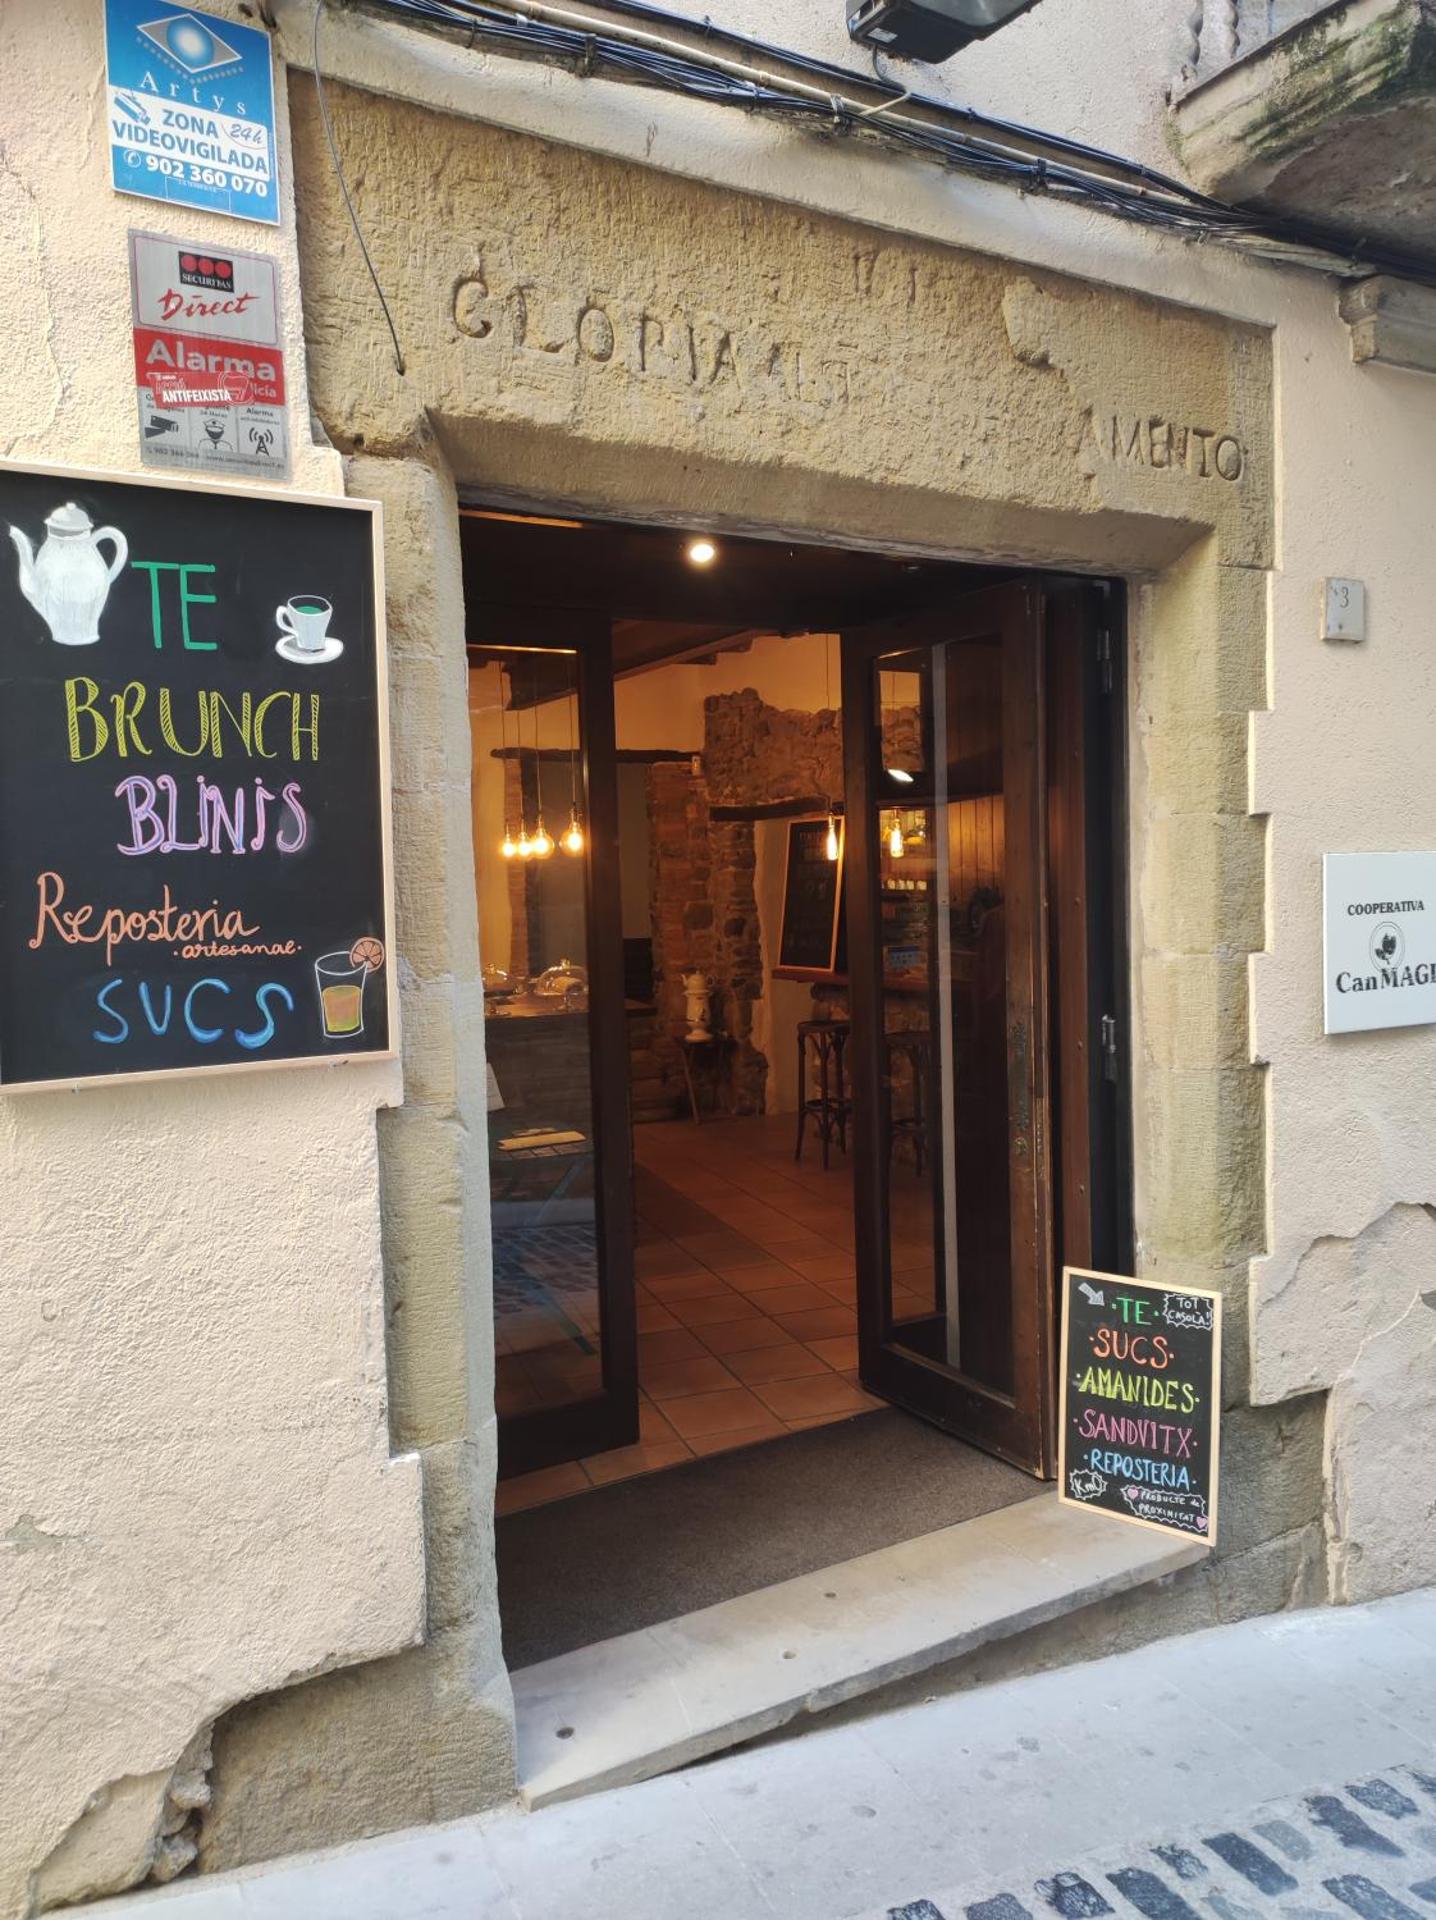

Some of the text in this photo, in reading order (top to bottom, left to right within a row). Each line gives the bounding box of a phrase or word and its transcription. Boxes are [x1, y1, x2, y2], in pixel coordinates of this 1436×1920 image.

[140, 71, 247, 115] Artys
[162, 109, 219, 139] ZONA
[230, 123, 262, 144] 24h
[112, 120, 268, 174] VIDEOVIGILADA
[146, 155, 184, 179] 902
[190, 168, 227, 188] 360
[231, 174, 268, 198] 070
[182, 273, 232, 289] SECURITAS
[157, 288, 261, 321] Direct
[145, 339, 277, 383] Alarma
[162, 388, 232, 403] ANTIFEIXISTA
[131, 561, 218, 650] TE
[65, 676, 320, 762] BRUNCH
[29, 871, 260, 966] Reposteria
[1347, 900, 1424, 916] COOPERATIVA
[1336, 971, 1378, 994] Can
[1116, 1297, 1152, 1325] TE
[1093, 1328, 1168, 1369] SUCS
[1078, 1366, 1194, 1413] AMANIDES
[1079, 1408, 1192, 1458] SANDVITX
[1090, 1448, 1190, 1491] REPOSTERIA
[1138, 1502, 1196, 1522] PROXIMITAT
[1141, 1490, 1186, 1505] PRODUCTE
